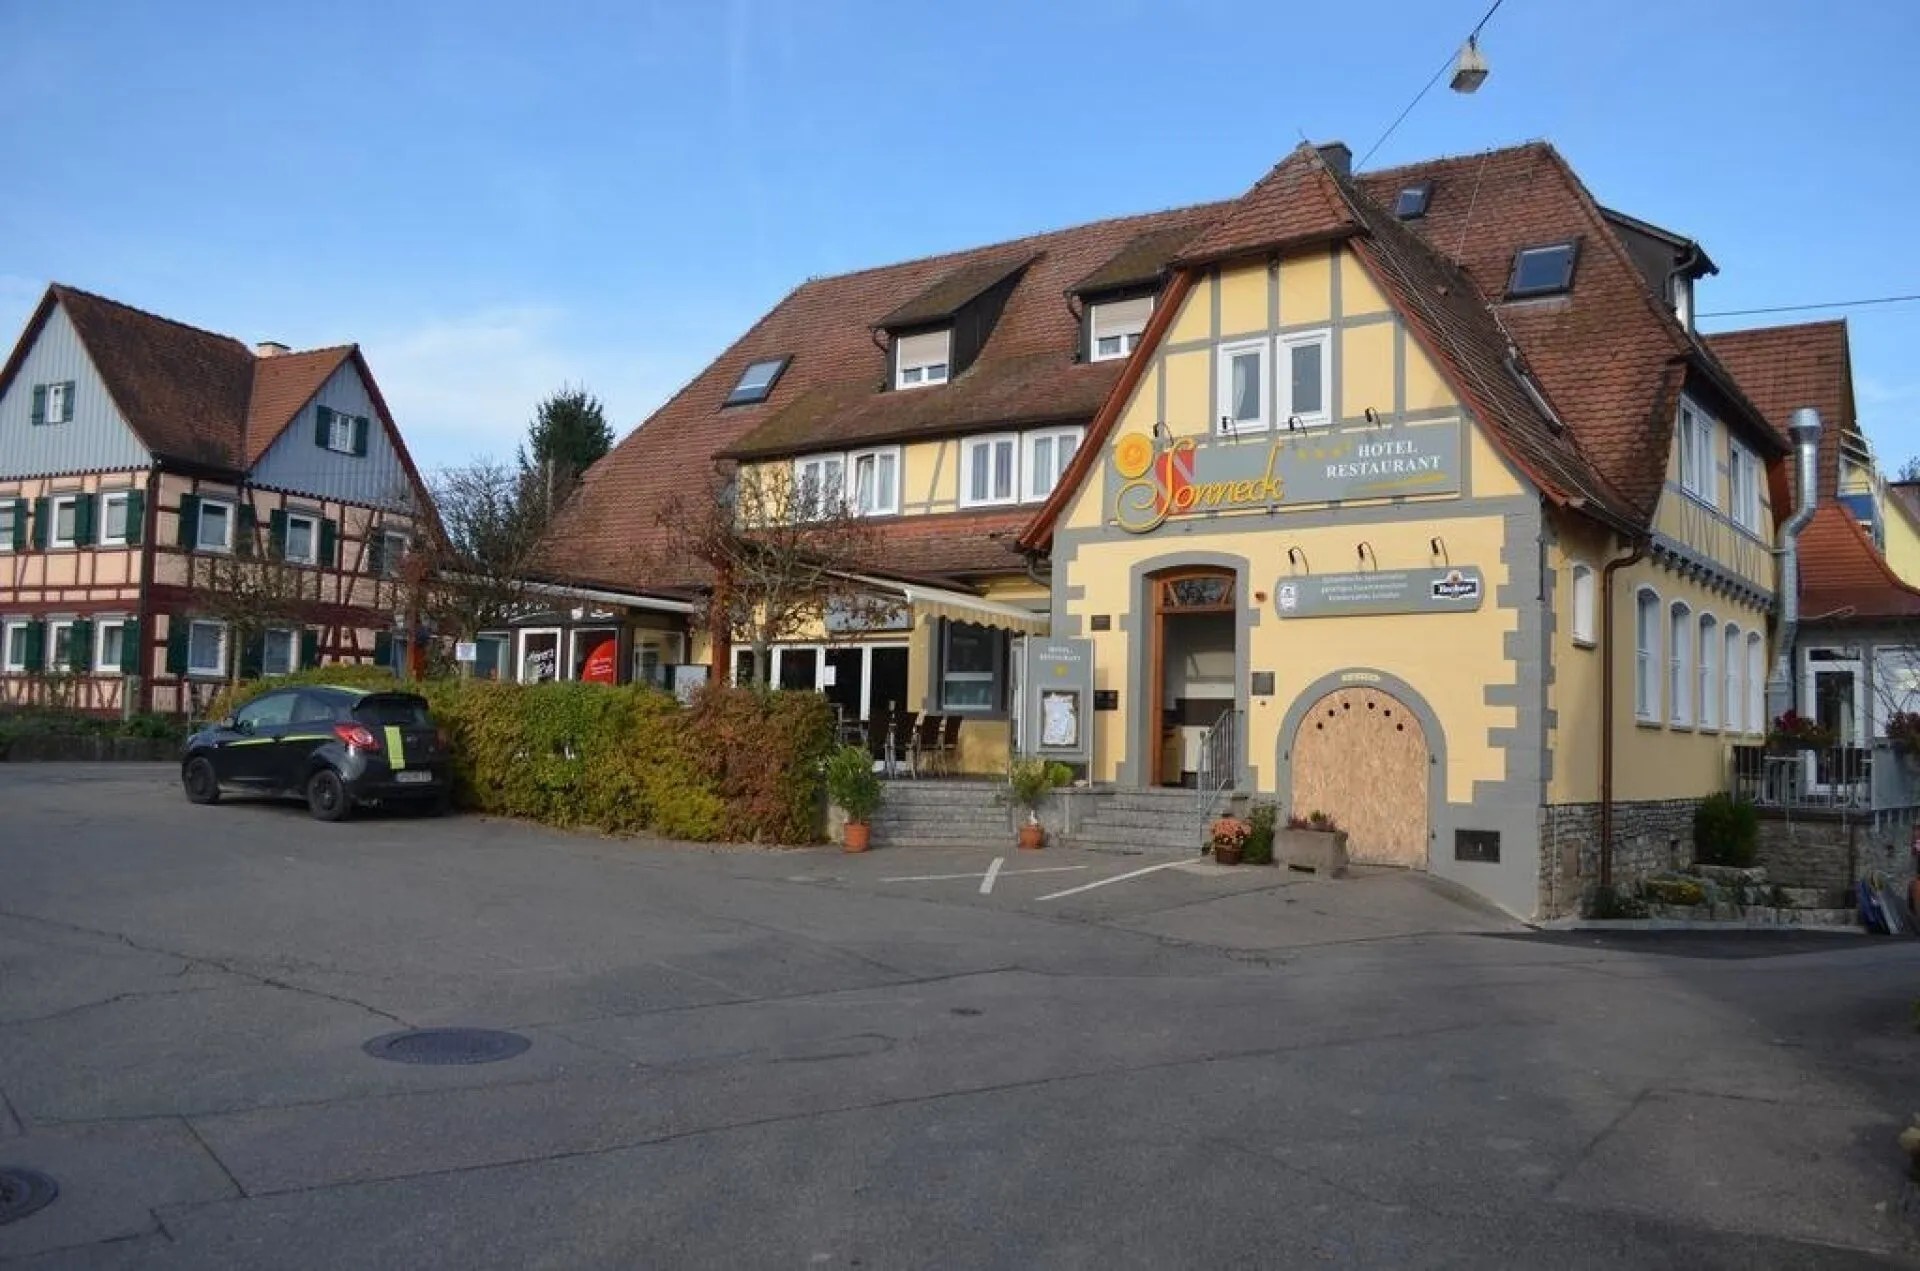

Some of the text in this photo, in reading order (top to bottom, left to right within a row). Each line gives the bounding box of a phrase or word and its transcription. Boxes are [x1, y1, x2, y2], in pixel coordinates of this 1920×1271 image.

[1358, 440, 1419, 458] HOTEL
[1326, 455, 1441, 478] RESTAURANT
[1115, 436, 1285, 533] Sonneck
